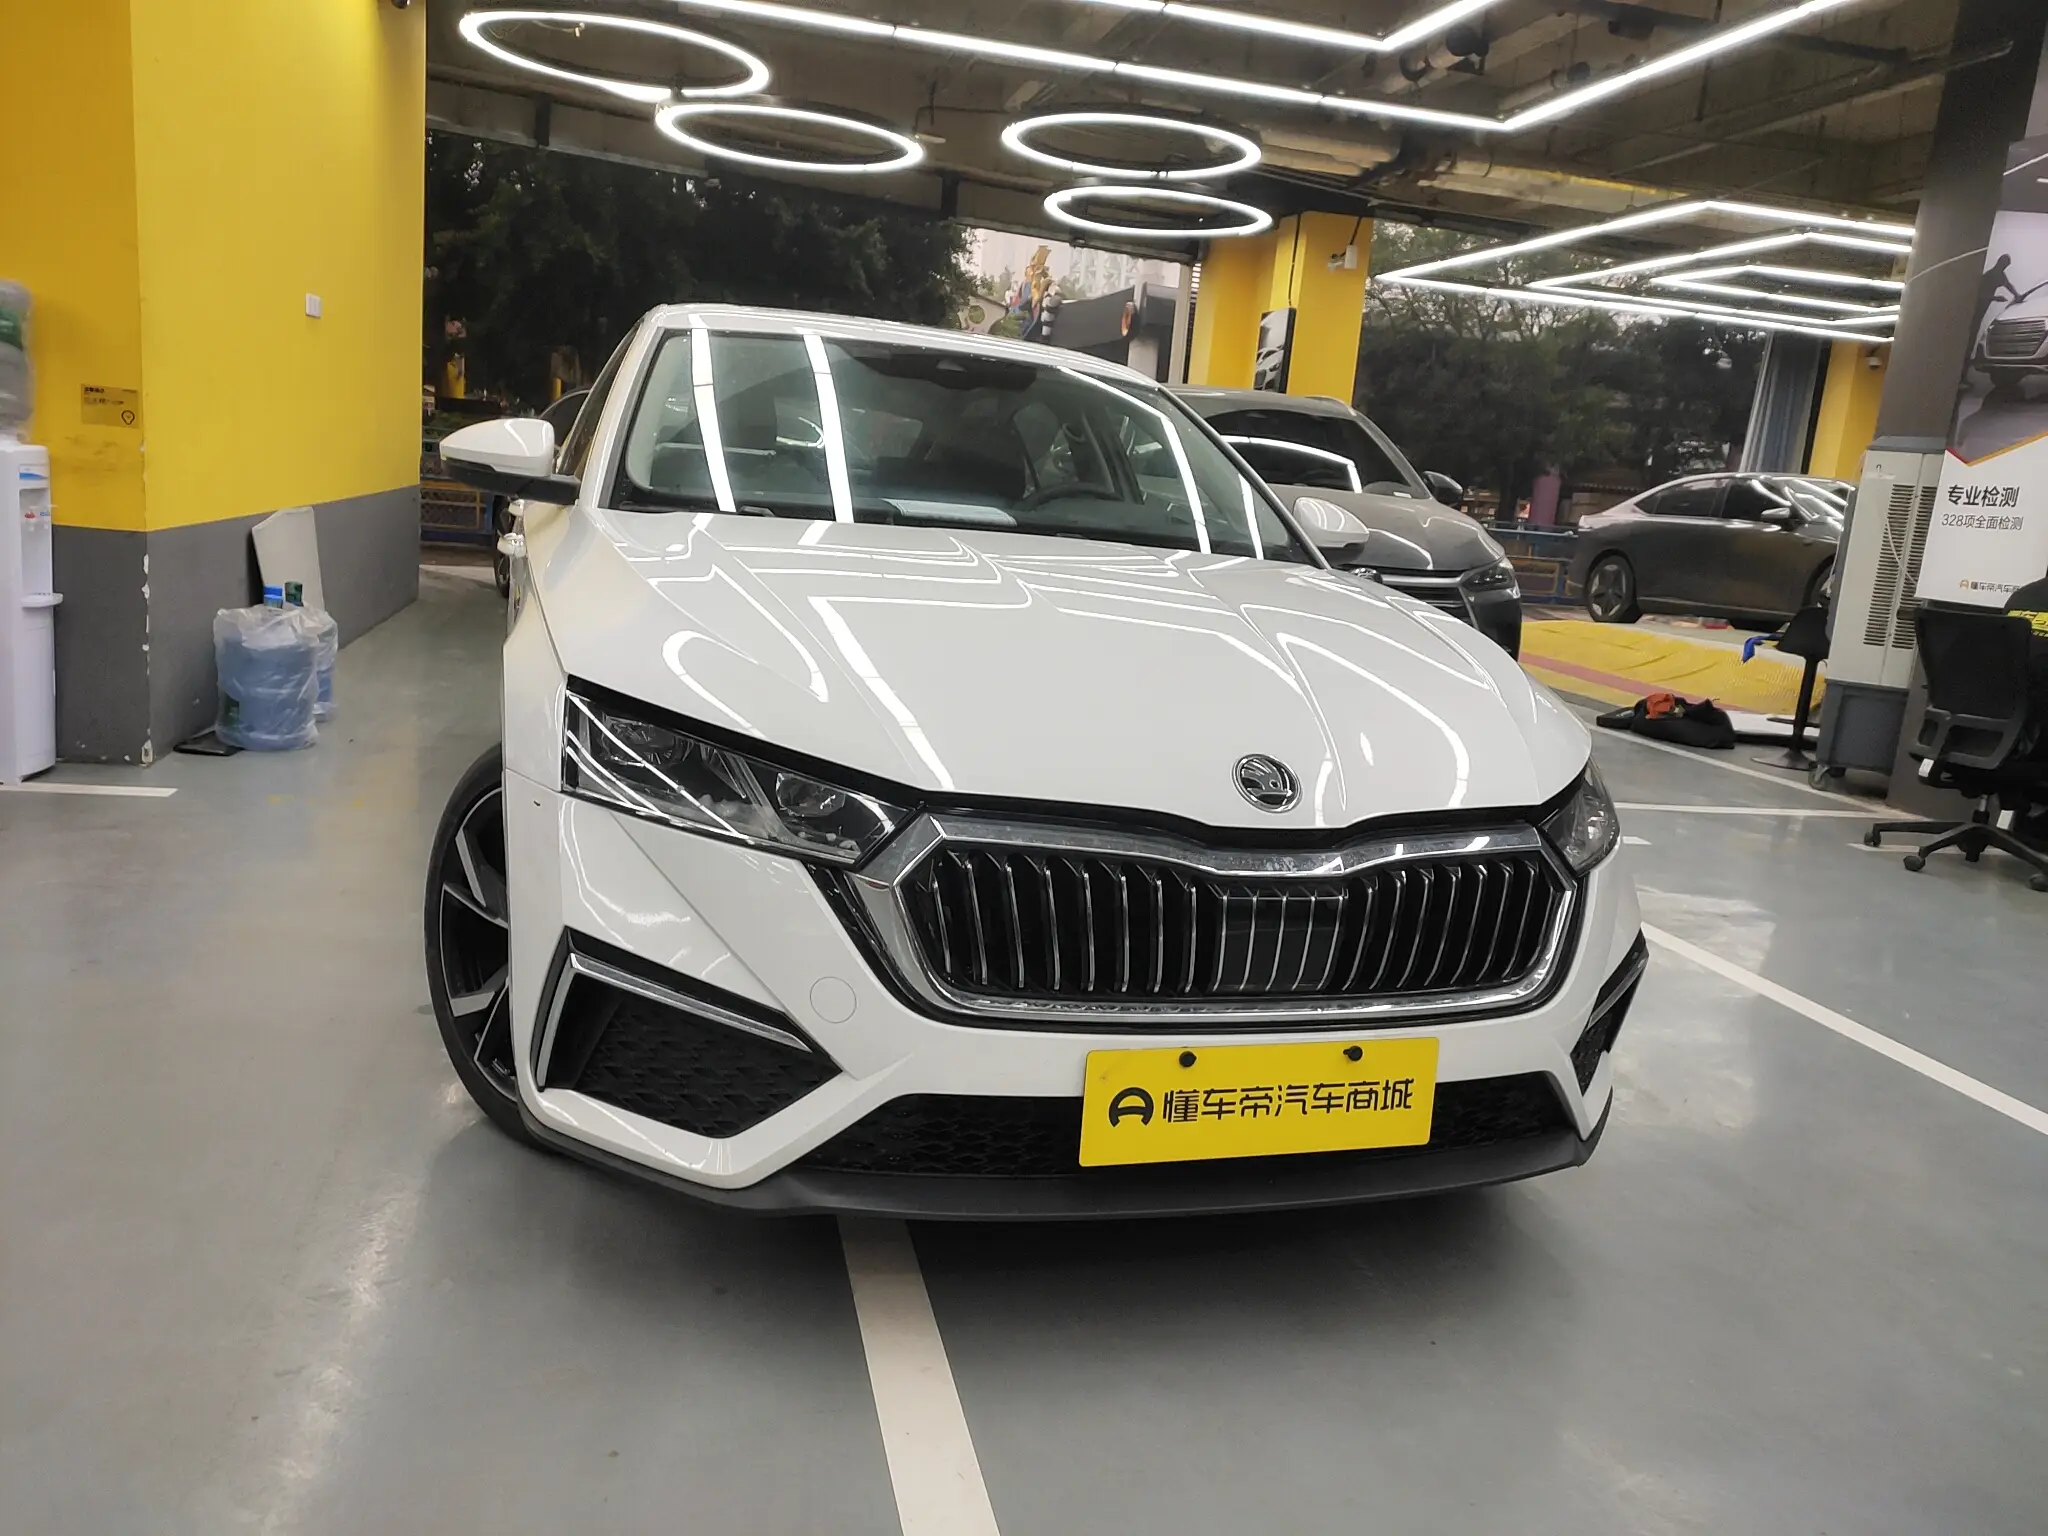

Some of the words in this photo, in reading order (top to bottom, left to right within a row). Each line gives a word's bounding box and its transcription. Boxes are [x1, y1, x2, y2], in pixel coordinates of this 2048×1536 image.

[1948, 485, 2019, 508] 专业检测
[1942, 513, 2023, 530] 328项全面检测
[1162, 1078, 1415, 1123] 懂车帝汽车商城
